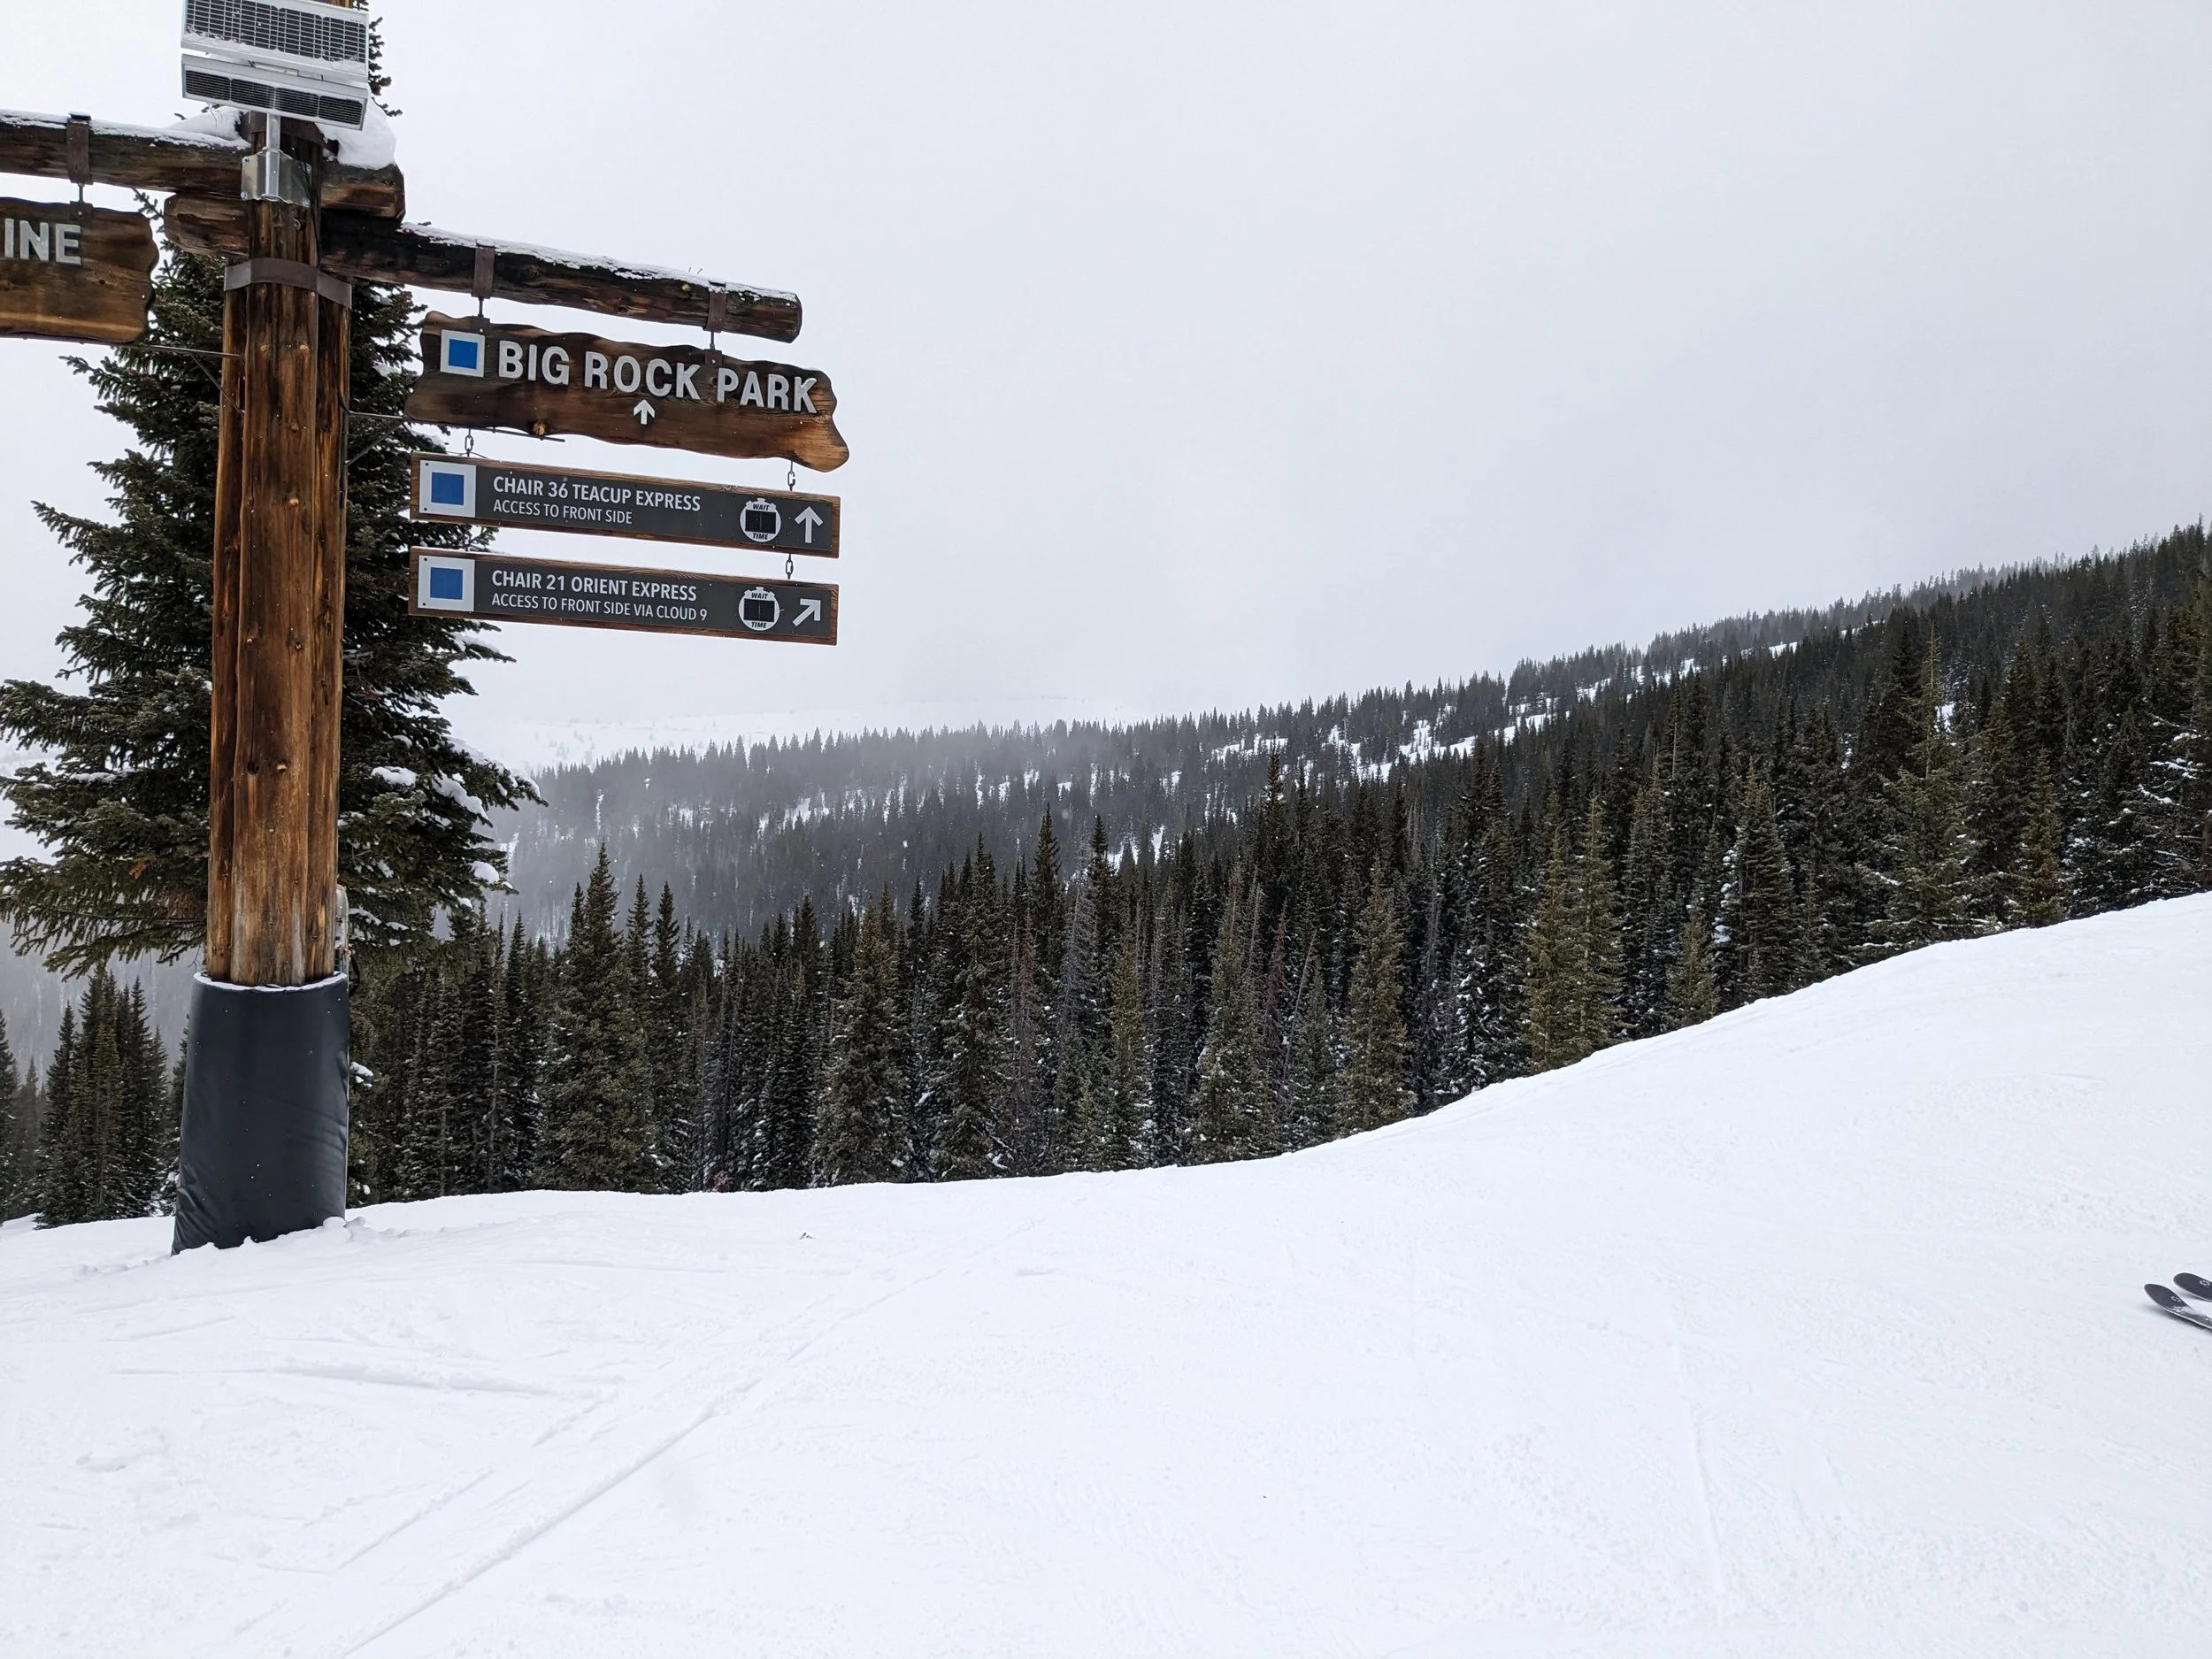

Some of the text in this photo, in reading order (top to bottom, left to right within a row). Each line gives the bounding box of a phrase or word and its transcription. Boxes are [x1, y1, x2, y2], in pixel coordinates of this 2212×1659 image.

[4, 218, 81, 265] INE
[498, 340, 818, 414] BIG ROCK PARK
[493, 476, 701, 511] CHAIR 36 TEACUP EXPRESS
[752, 503, 770, 511] WAIT
[493, 499, 633, 525] ACCESS TO FRONT SIDE
[491, 570, 697, 602] CHAIR 21 ORIENT EXPRESS
[491, 593, 708, 621] ACCESS TO FRONT SIDE VIA CLOUD 9
